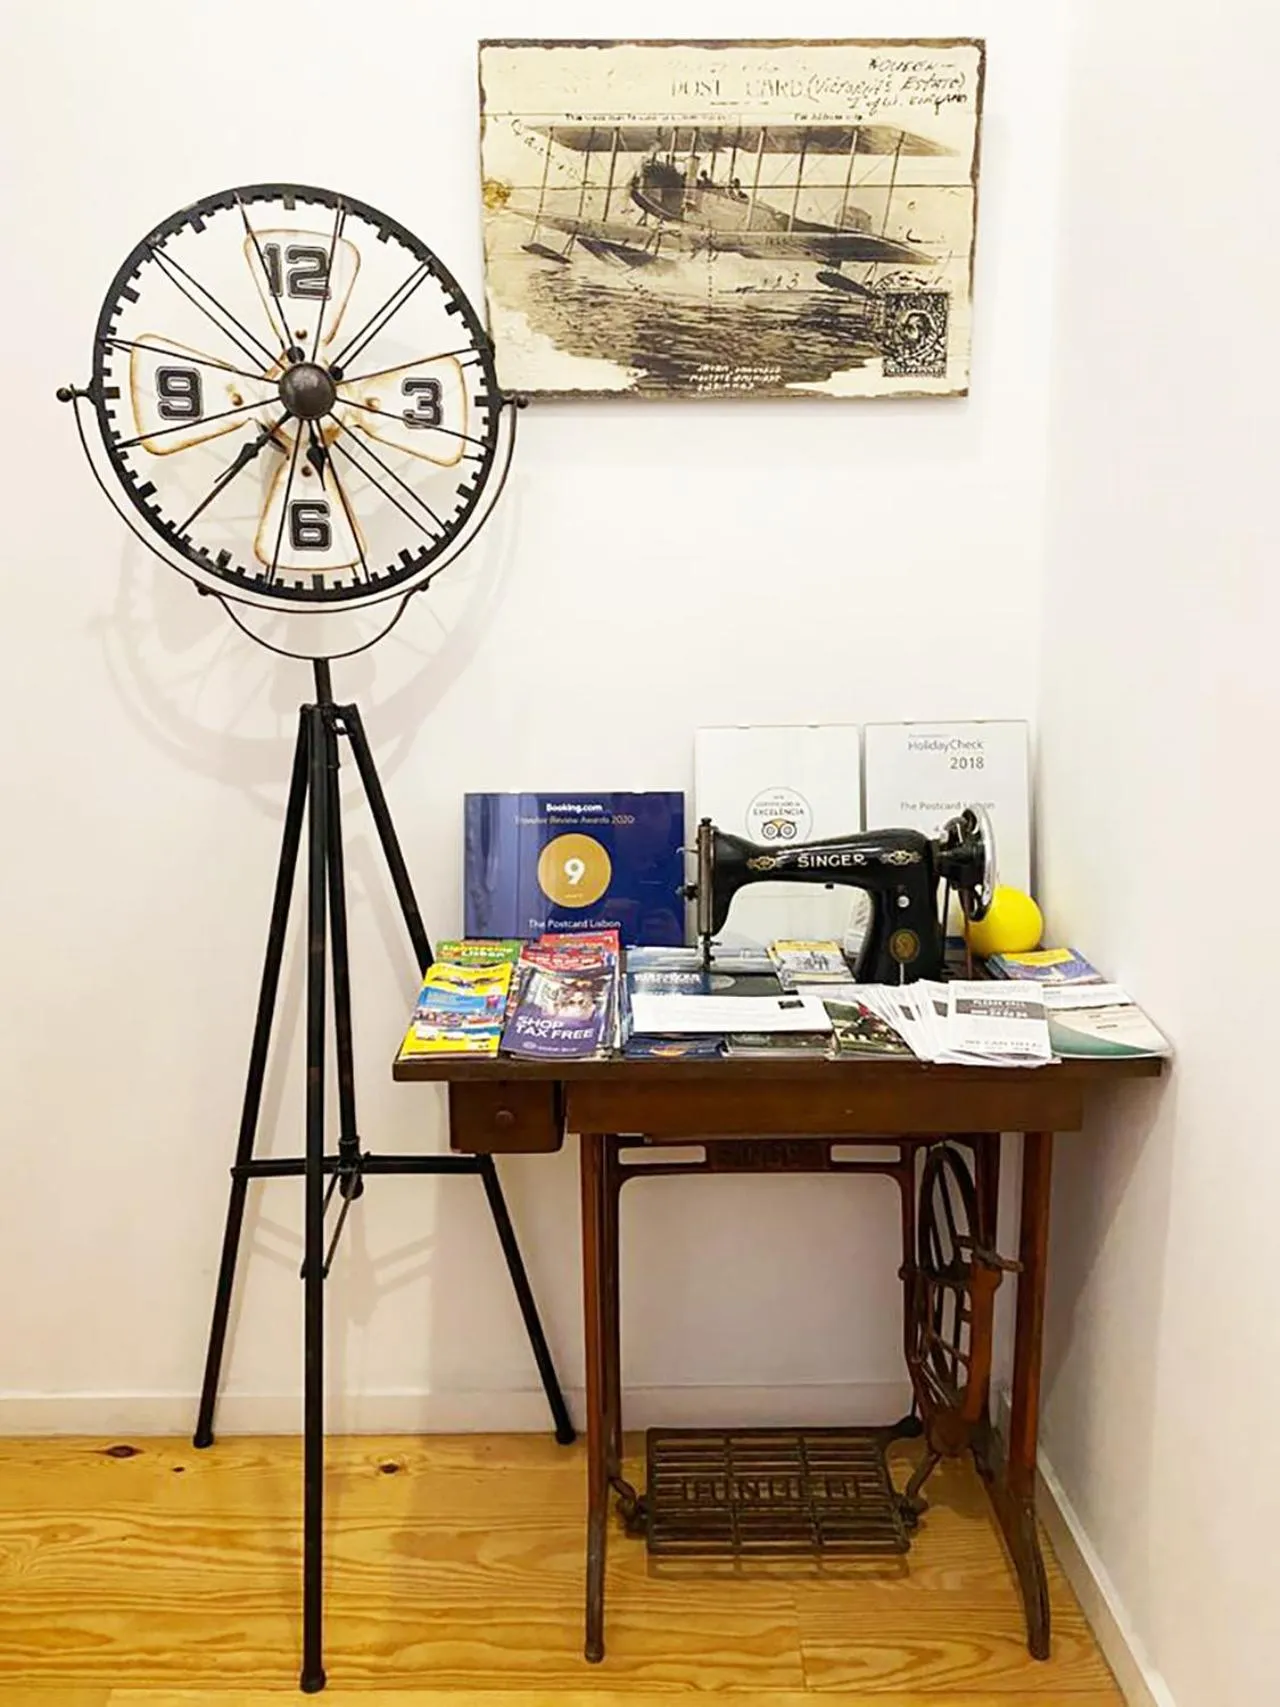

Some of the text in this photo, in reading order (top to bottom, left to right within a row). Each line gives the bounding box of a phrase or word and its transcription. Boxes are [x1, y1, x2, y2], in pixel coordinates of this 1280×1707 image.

[671, 79, 803, 97] POST CARD
[264, 243, 331, 301] 12
[154, 365, 204, 420] 9
[401, 377, 445, 430] 3
[287, 499, 332, 551] 6
[908, 738, 985, 752] HolidayCheck
[950, 756, 985, 770] 2018
[546, 803, 603, 814] Booking.com
[919, 801, 961, 811] Postcard
[797, 853, 868, 868] SINGER
[564, 857, 586, 885] 9
[529, 919, 621, 928] The Postcard Lisbon
[517, 1016, 564, 1030] SHOP
[515, 1023, 595, 1040] TAX FREE
